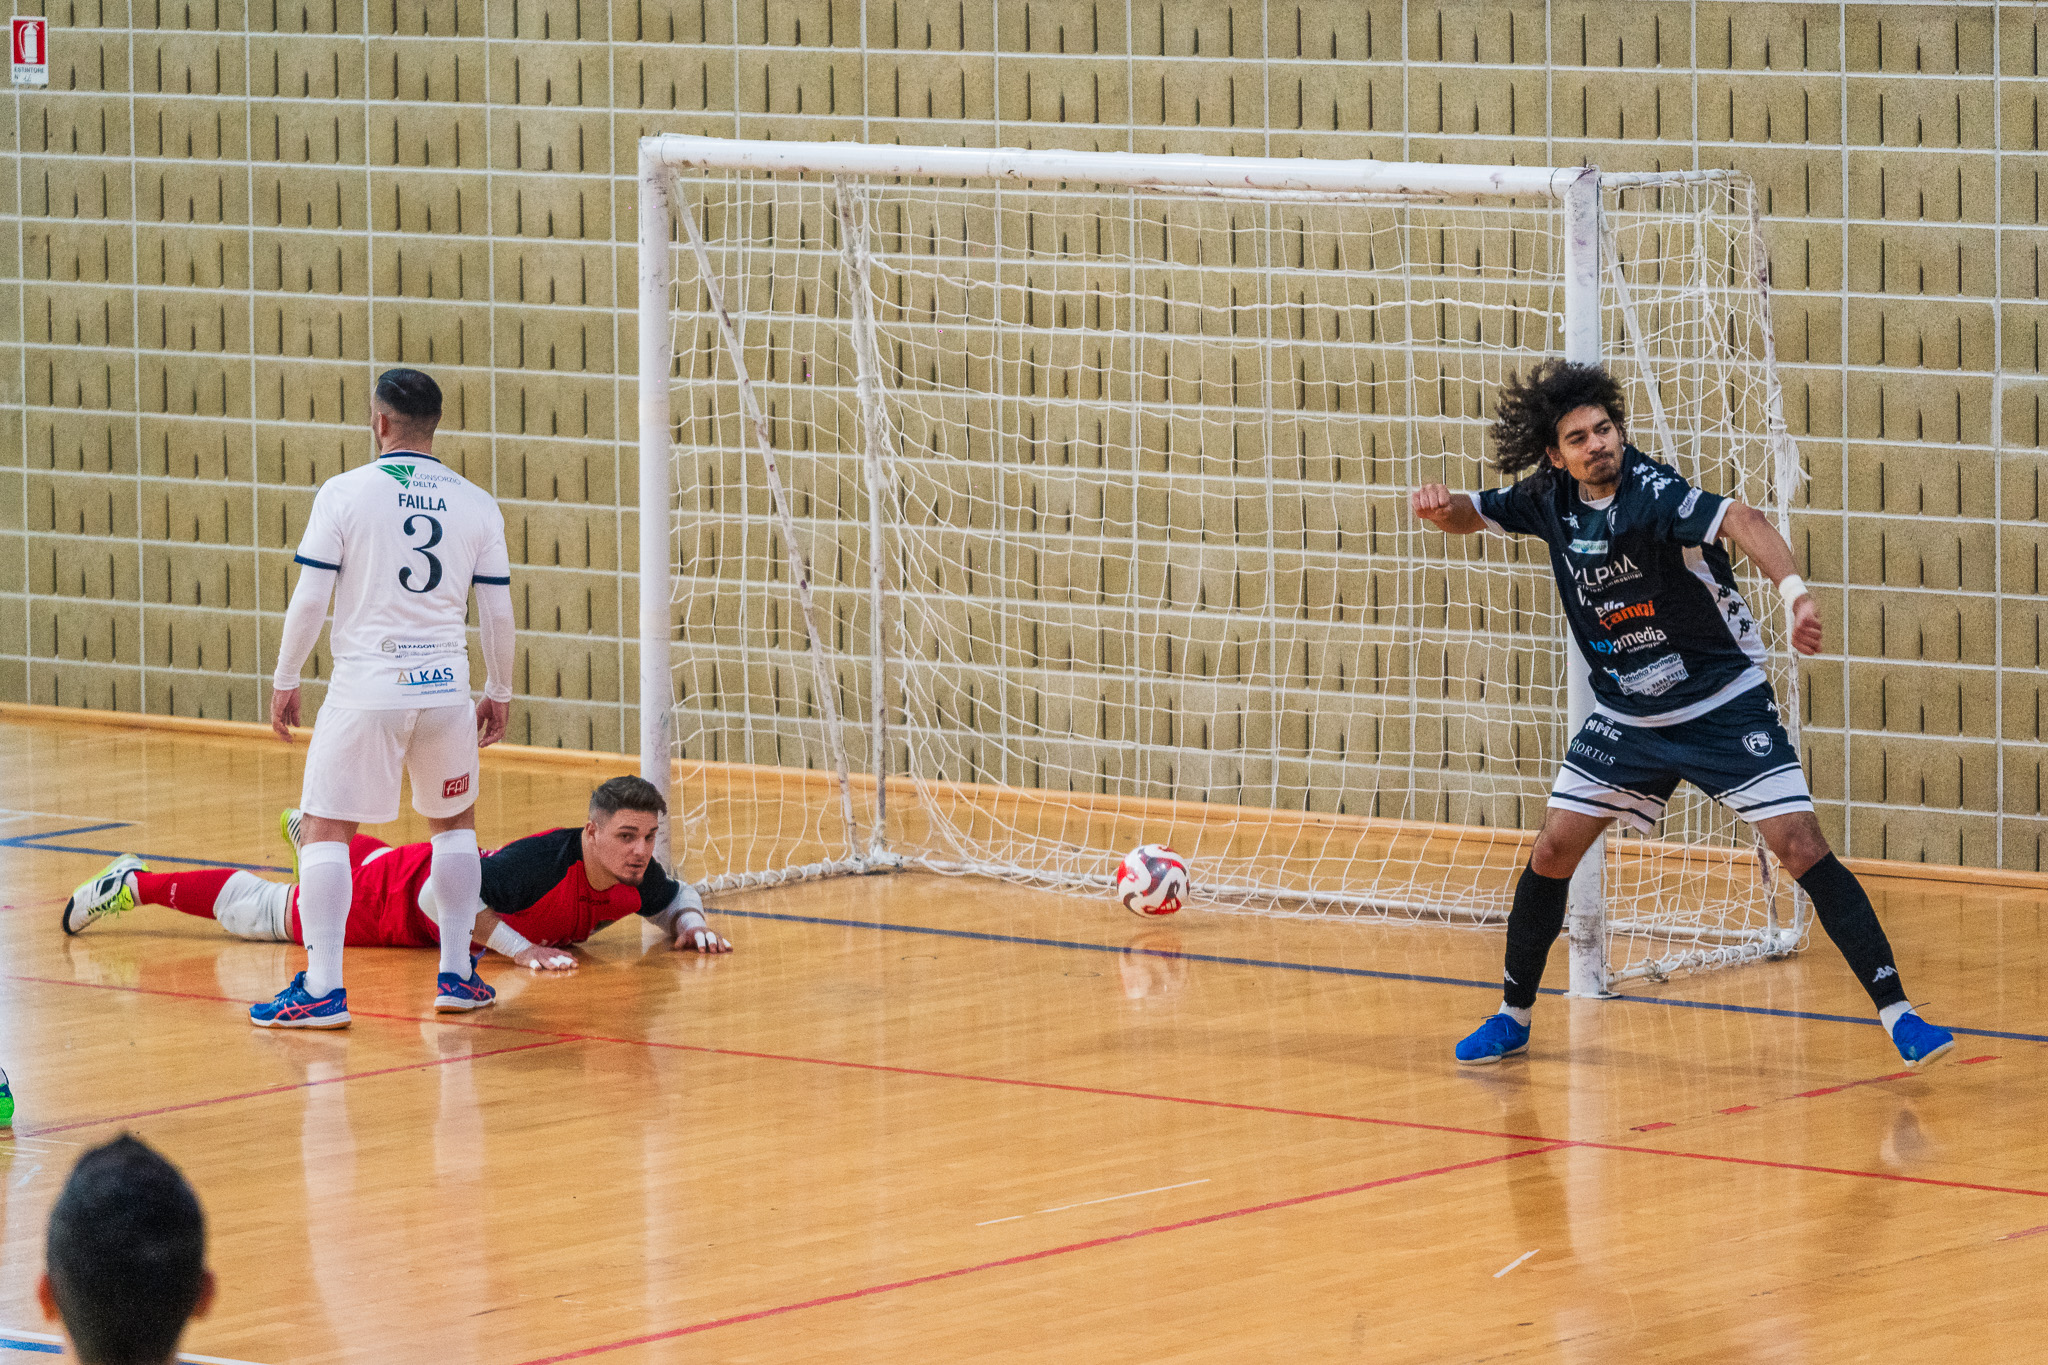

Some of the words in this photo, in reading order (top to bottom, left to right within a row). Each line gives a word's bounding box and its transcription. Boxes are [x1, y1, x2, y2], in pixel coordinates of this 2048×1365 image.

[412, 480, 438, 489] DELTA
[414, 471, 461, 486] CONSORZIO
[398, 492, 447, 512] FAILLA
[398, 513, 443, 594] 3
[1649, 653, 1681, 672] Ponteggi
[397, 666, 454, 684] ALKAS
[1585, 719, 1622, 742] NMC
